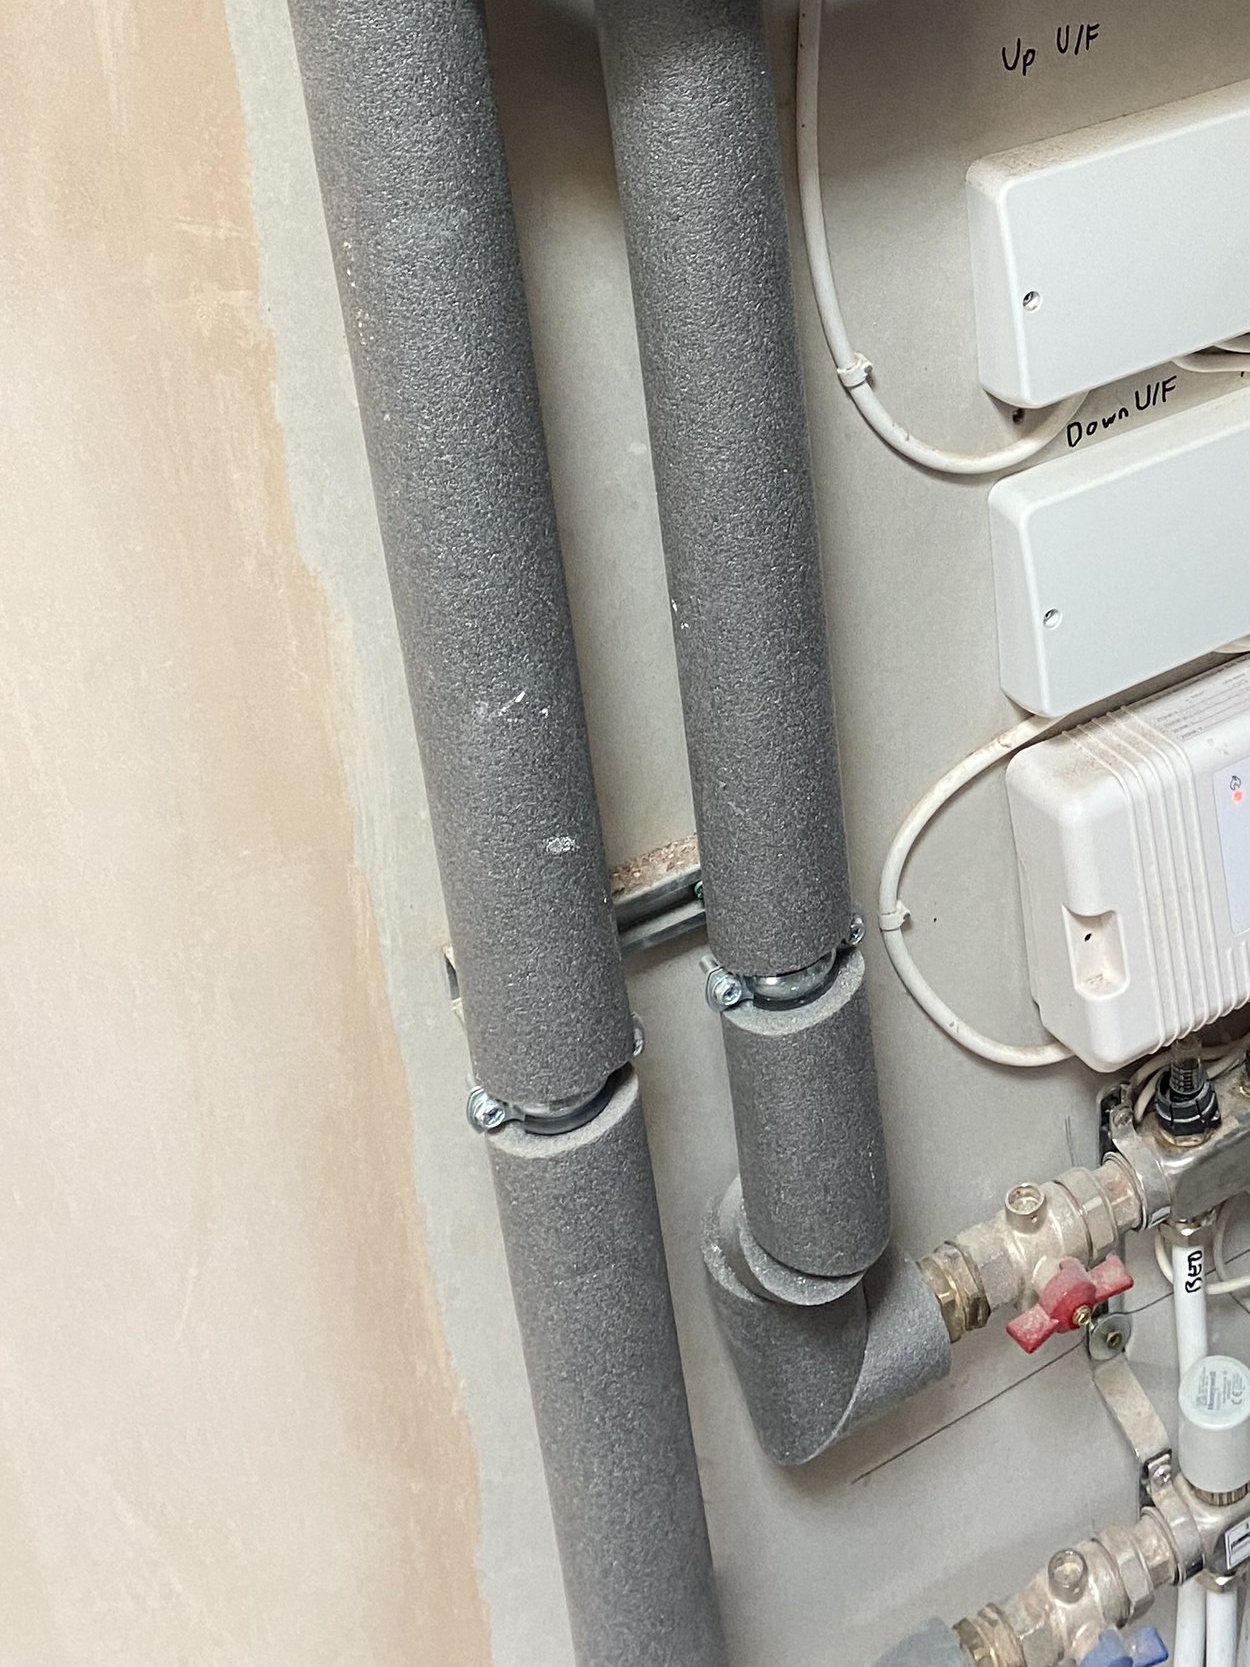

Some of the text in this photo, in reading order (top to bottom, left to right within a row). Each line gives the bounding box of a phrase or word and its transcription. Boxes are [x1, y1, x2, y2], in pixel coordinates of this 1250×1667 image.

[1000, 37, 1037, 77] Up
[1066, 374, 1178, 448] Down U/F
